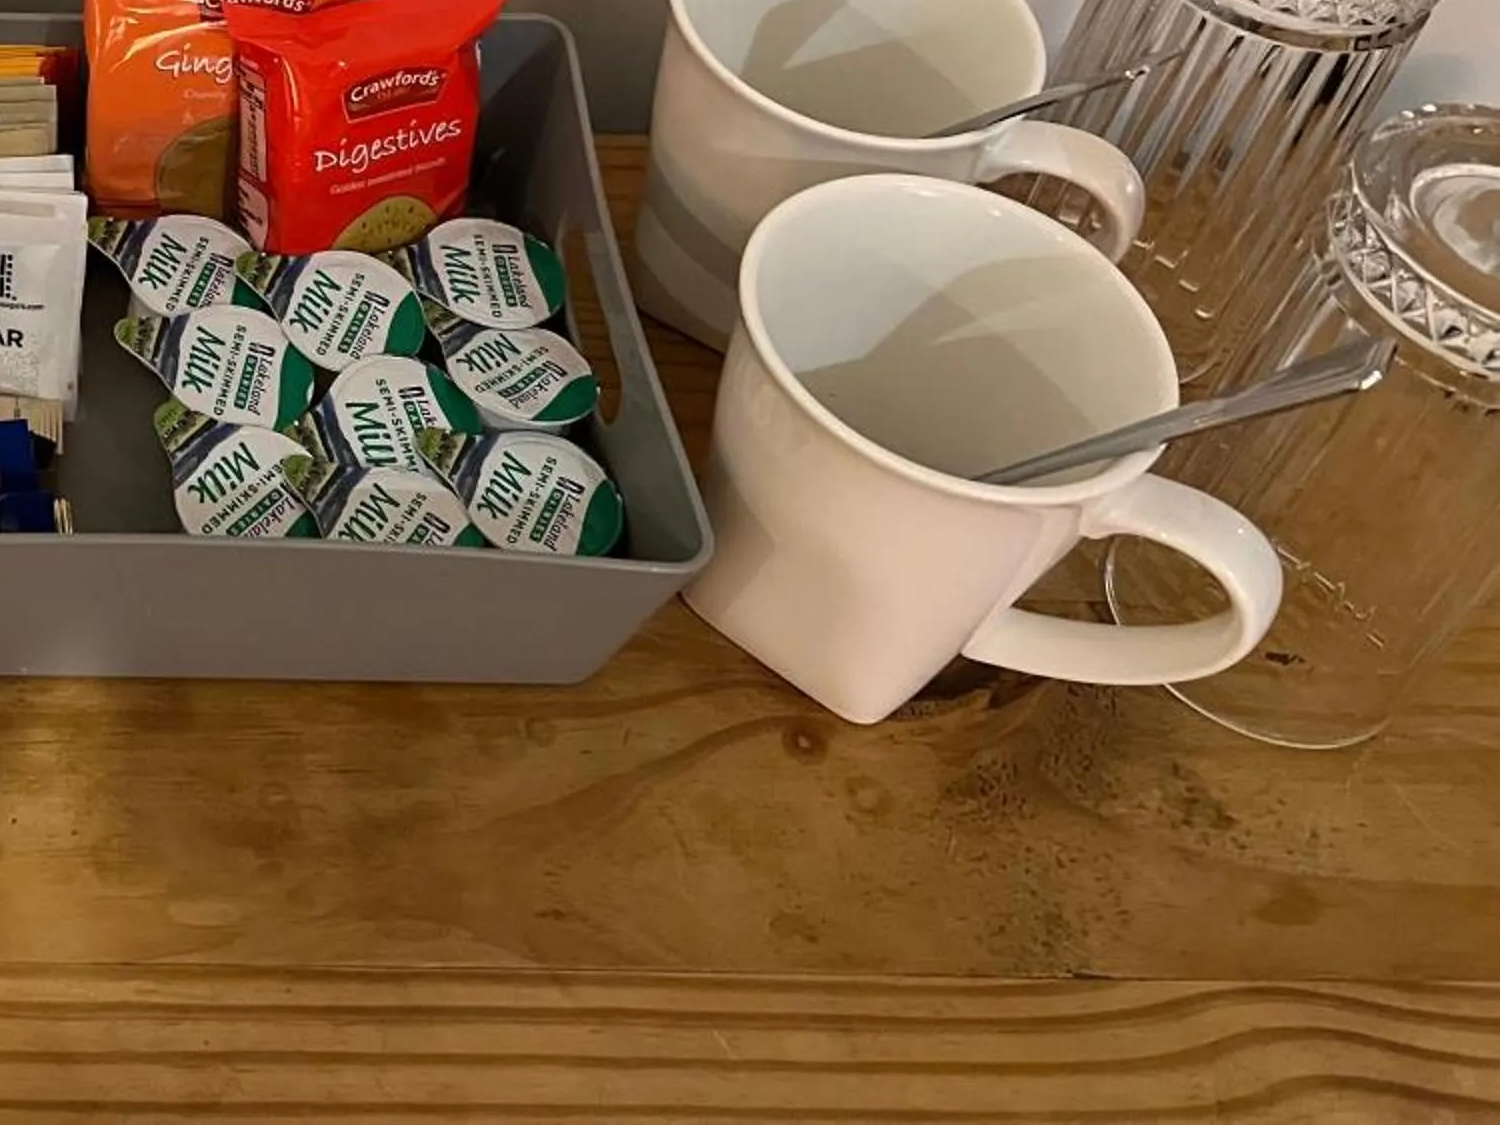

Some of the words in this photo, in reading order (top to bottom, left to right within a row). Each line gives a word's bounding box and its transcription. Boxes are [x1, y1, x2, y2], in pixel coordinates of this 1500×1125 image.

[155, 42, 233, 84] Ging
[350, 69, 441, 102] Crawford's
[313, 118, 463, 174] Digestives
[138, 231, 188, 290] Milk
[439, 244, 481, 304] Milk
[289, 268, 342, 333] Milk
[316, 272, 365, 355] SEMI-SKIMMED
[181, 325, 226, 393] Milk
[213, 324, 247, 416] SEMI-SKIMMED
[455, 332, 522, 374] Milk
[474, 346, 549, 393] SEMI-SKIMMED
[375, 378, 420, 473] SEMI-SKIMM
[187, 441, 261, 504] Milk
[476, 450, 533, 520] Milk
[506, 456, 558, 544] SEMI-SKIMMED
